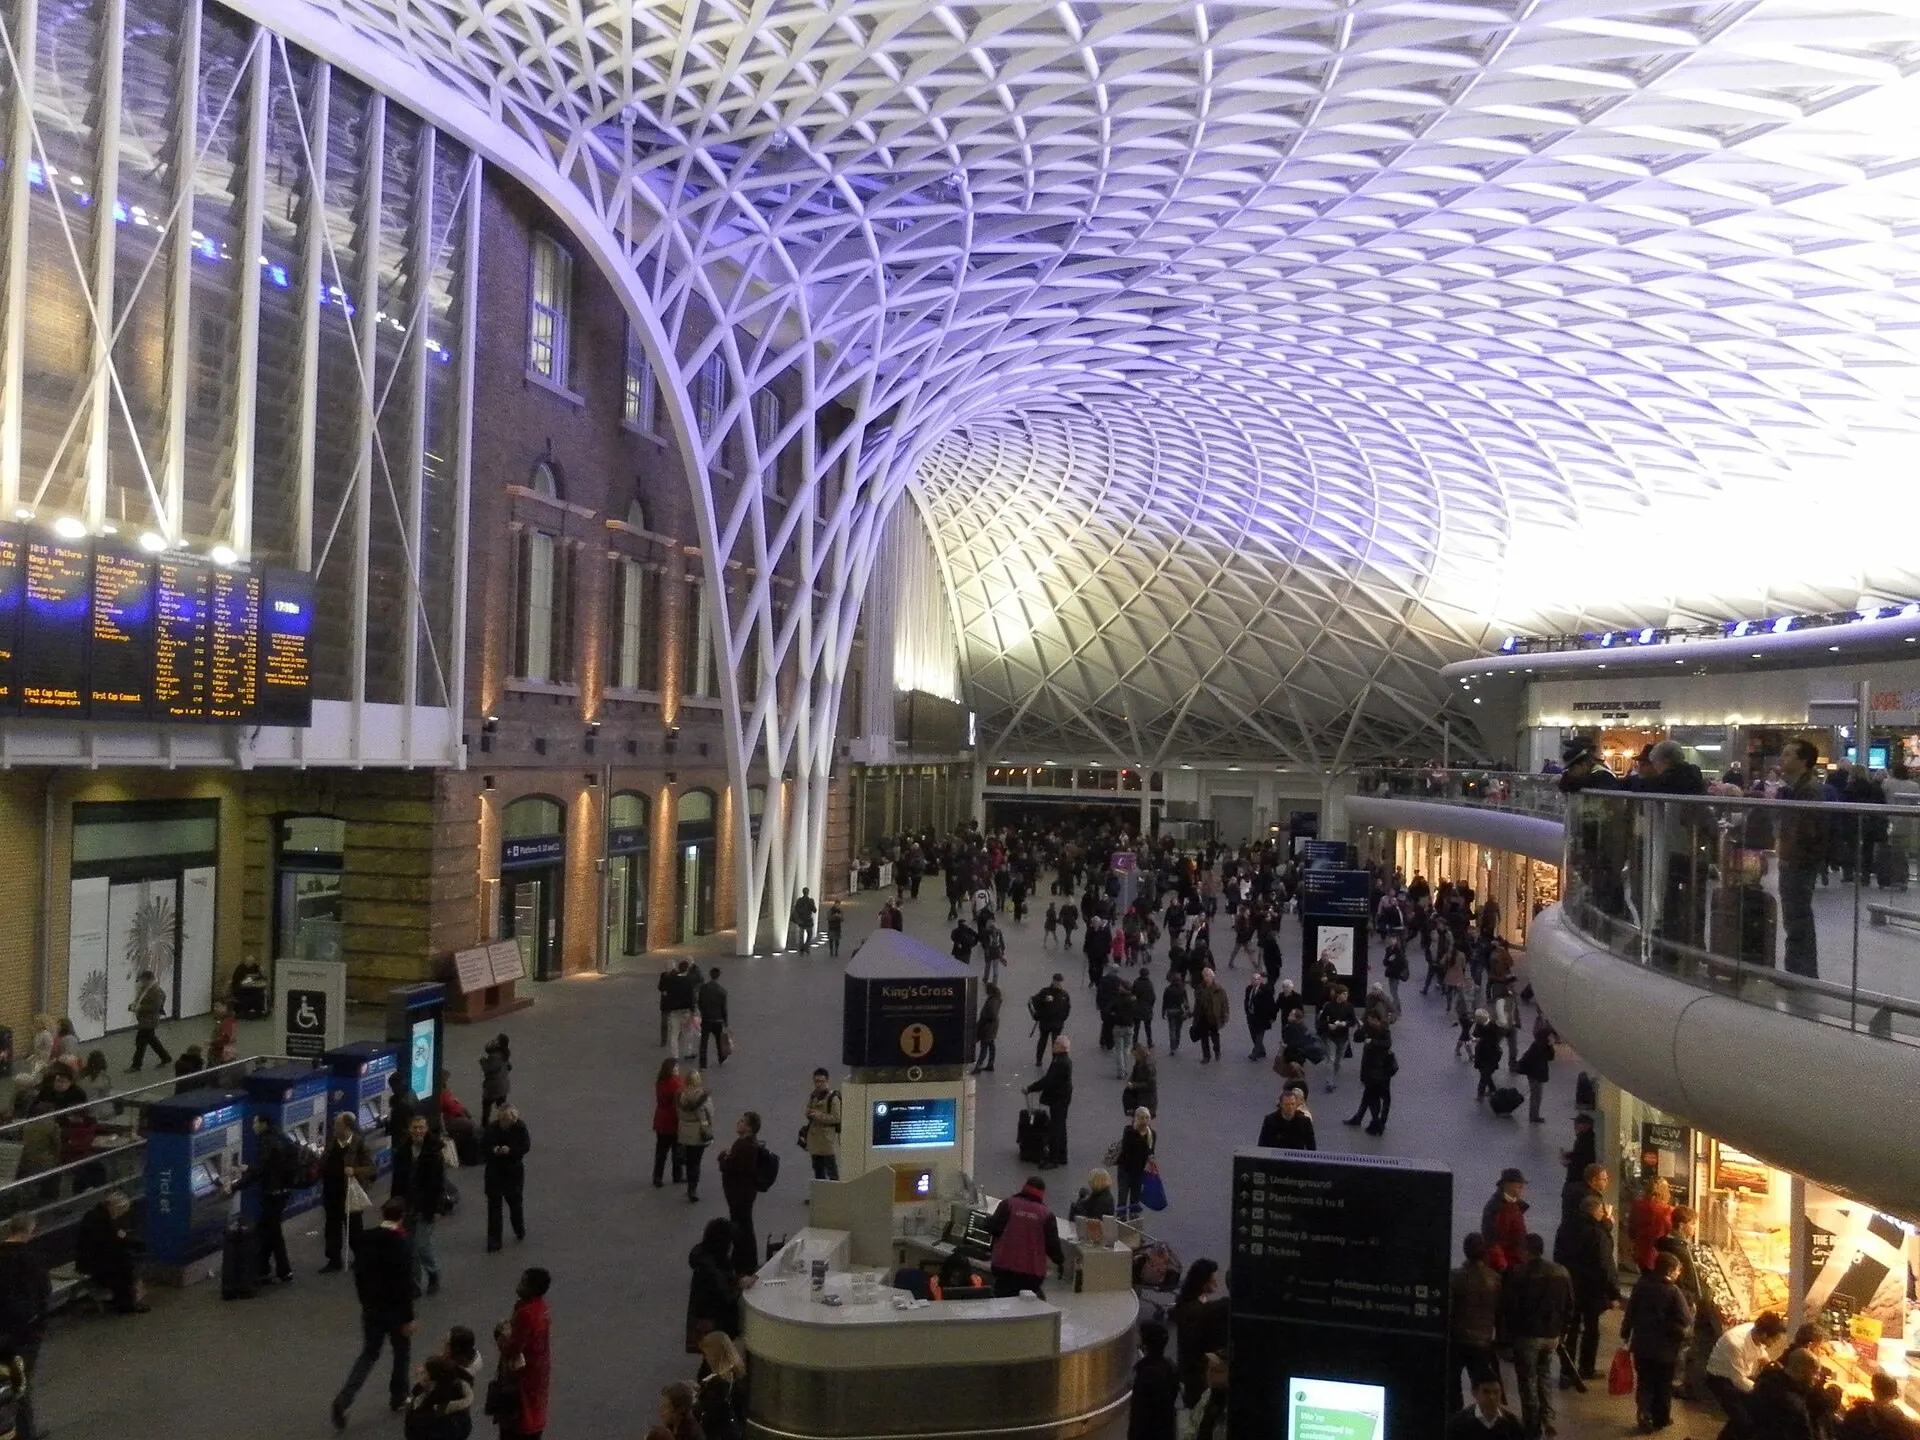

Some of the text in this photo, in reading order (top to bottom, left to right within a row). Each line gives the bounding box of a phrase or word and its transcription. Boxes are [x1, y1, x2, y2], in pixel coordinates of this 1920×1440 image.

[24, 688, 78, 699] First Cap Connect
[92, 692, 141, 702] First Cap Connect
[882, 984, 954, 999] King's Cross
[1652, 1126, 1681, 1139] NEW
[1269, 1175, 1332, 1189] Underground
[1269, 1192, 1314, 1206] Platforms
[1269, 1210, 1292, 1220] Taxis
[1811, 1234, 1829, 1246] THE
[1268, 1245, 1301, 1257] Tickets
[1334, 1278, 1380, 1292] Platforms
